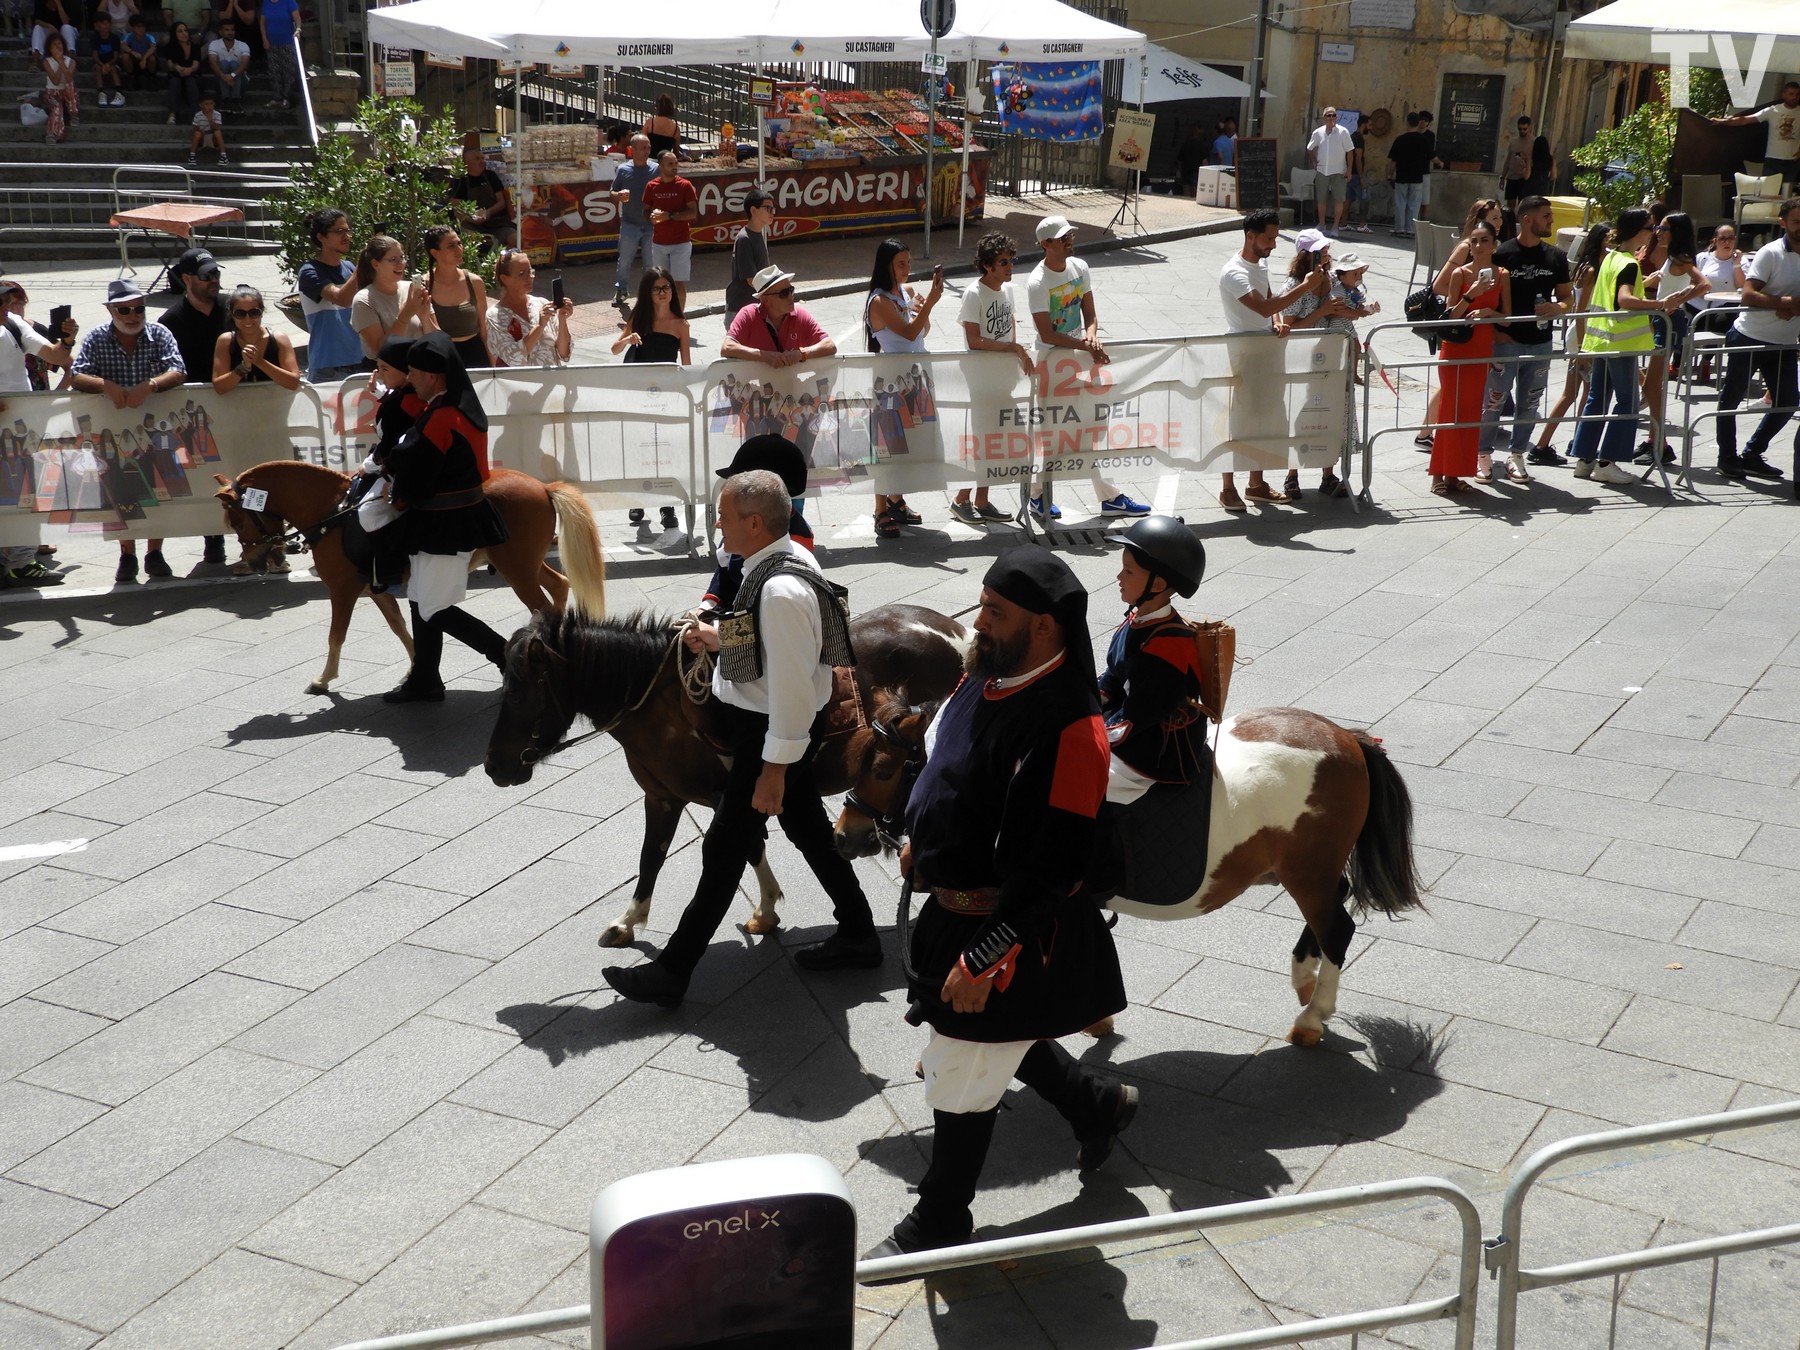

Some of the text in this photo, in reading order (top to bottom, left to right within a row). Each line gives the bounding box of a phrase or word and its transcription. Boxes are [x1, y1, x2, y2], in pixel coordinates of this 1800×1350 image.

[617, 44, 674, 56] SU CASTAGNERI
[845, 42, 895, 52] SU CASTAGNERI
[1043, 43, 1083, 54] SU CASTAGNERI
[1161, 67, 1203, 88] Leffe
[583, 171, 909, 223] S ASTAGNERI
[322, 388, 384, 436] 12
[999, 401, 1140, 428] FESTA DEL
[293, 442, 378, 465] FEST
[958, 421, 1183, 462] REDENTORE
[986, 464, 1039, 479] NUORO
[1091, 455, 1153, 470] AGOSTO
[683, 1209, 751, 1240] enel
